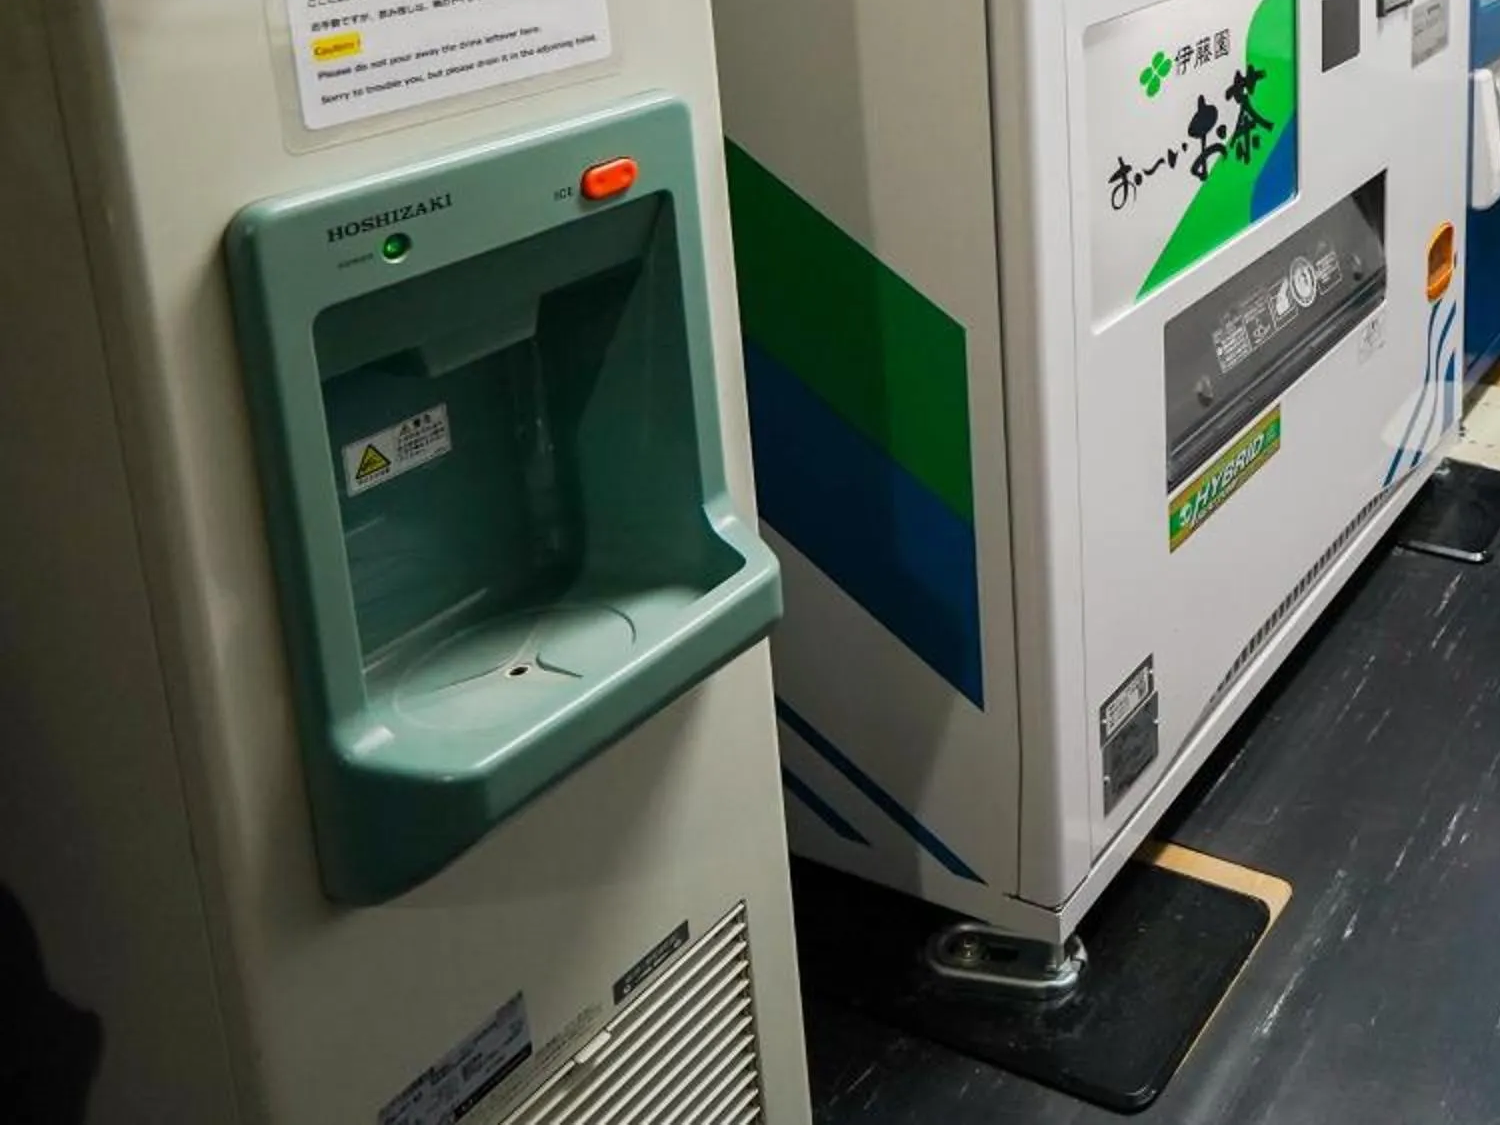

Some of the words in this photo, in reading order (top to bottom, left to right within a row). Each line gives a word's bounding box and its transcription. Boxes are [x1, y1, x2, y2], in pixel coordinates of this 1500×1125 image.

[317, 67, 352, 80] Please
[354, 63, 369, 72] do
[370, 58, 387, 68] not
[389, 54, 412, 66] pour
[415, 47, 440, 60] away
[1174, 28, 1232, 76] 伊藤園
[321, 90, 350, 104] Sorry
[352, 87, 364, 97] to
[427, 69, 443, 80] but
[445, 62, 475, 76] please
[327, 192, 454, 244] HOSHIZAKI
